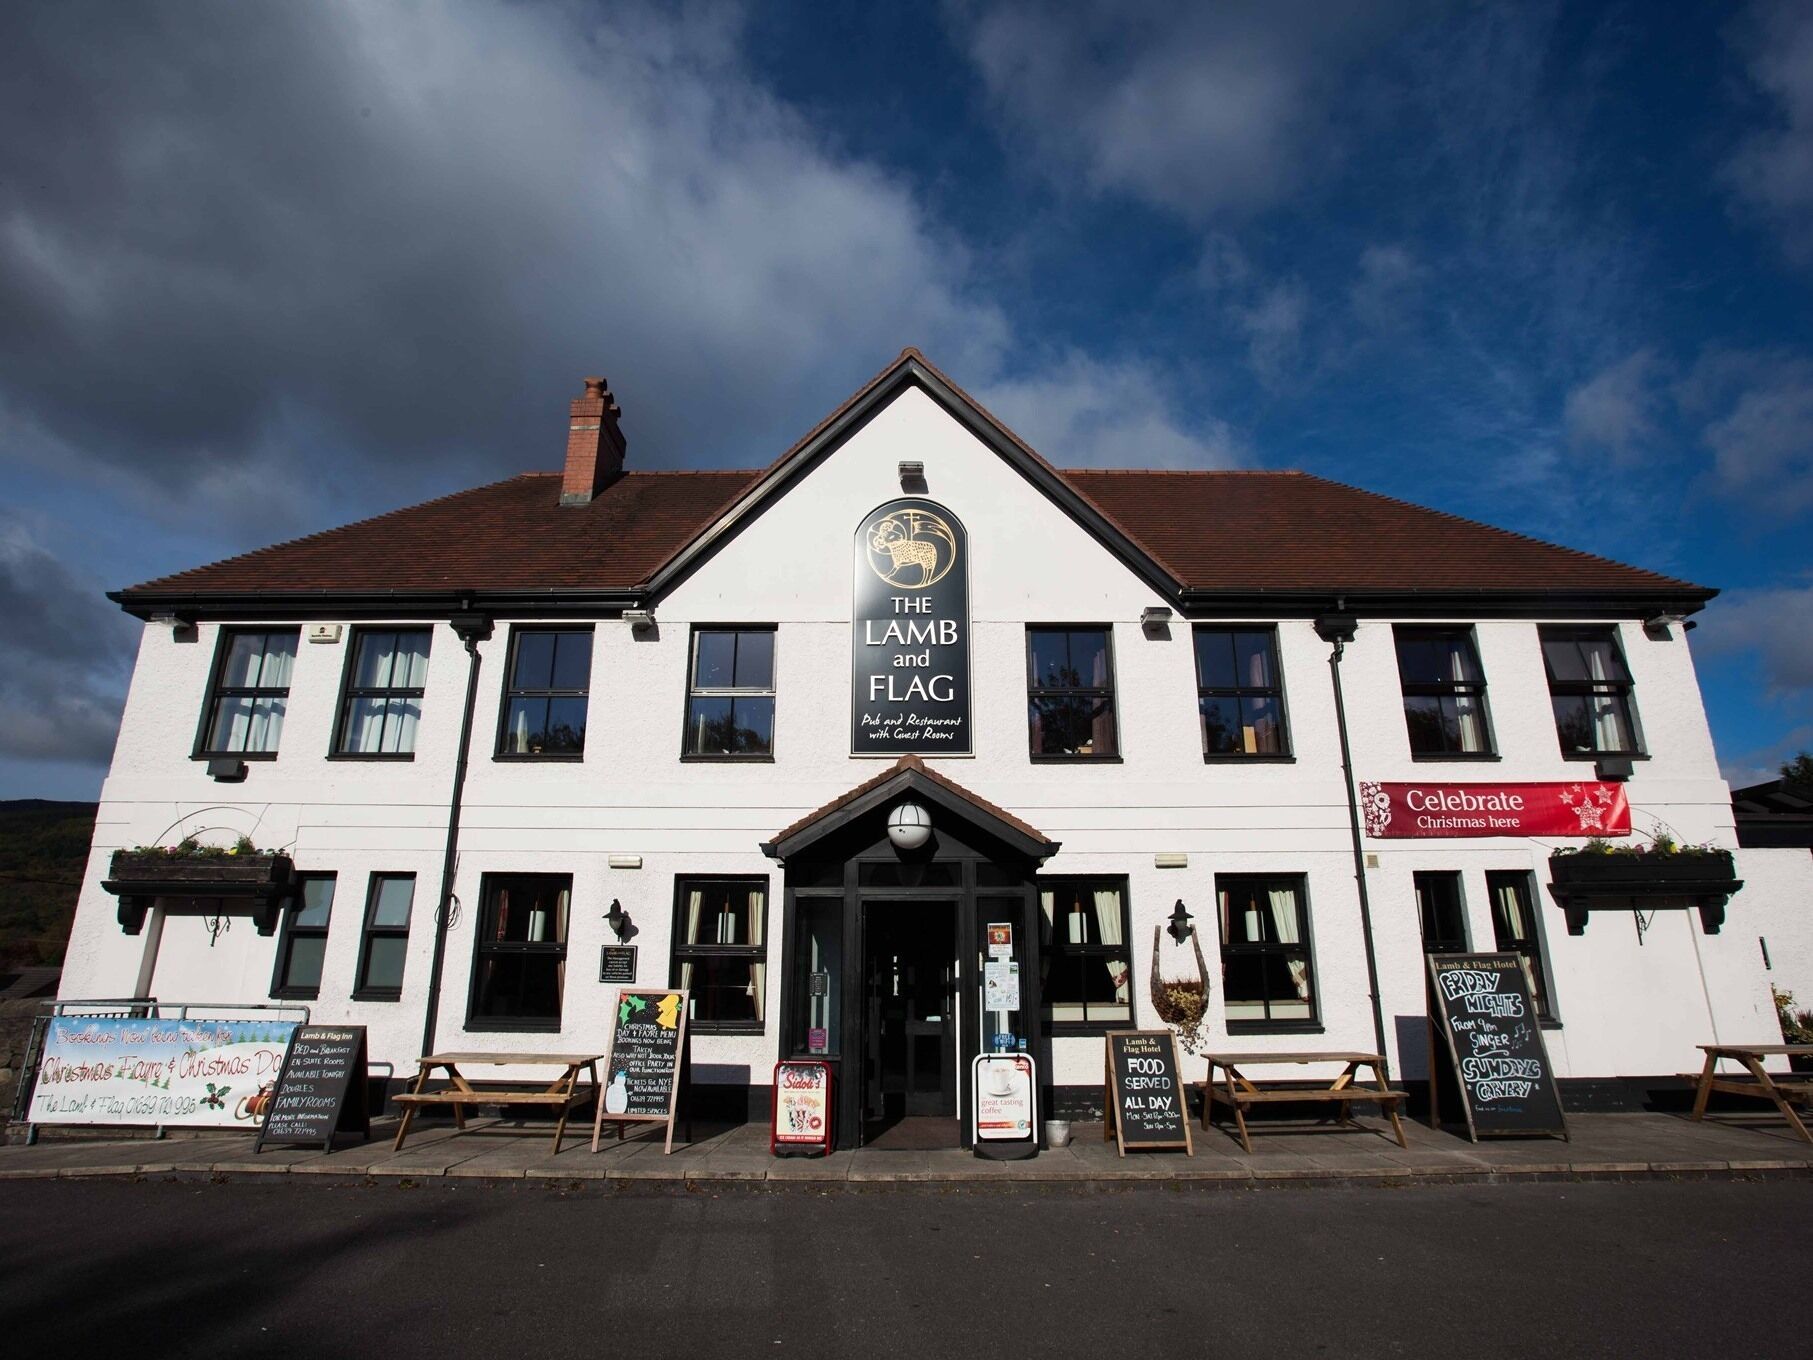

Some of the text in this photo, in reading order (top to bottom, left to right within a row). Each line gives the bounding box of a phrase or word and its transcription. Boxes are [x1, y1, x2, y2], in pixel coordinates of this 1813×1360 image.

[890, 597, 932, 614] THE
[866, 619, 958, 645] LAMB
[893, 649, 930, 667] and
[869, 674, 954, 702] FLAG
[861, 713, 962, 726] Pub and Restaurant
[869, 727, 954, 739] with Guest Rooms
[1406, 790, 1525, 812] Celebrate
[1417, 815, 1520, 829] Christmas here
[1435, 960, 1517, 970] Lamb & Flag Hotel
[1439, 970, 1500, 1001] FRIDAY
[1464, 993, 1525, 1017] NIGHTS
[624, 1023, 657, 1031] CHRISTMAS
[1451, 1016, 1476, 1032] FROM
[300, 1032, 320, 1040] Lamb
[320, 1032, 326, 1040] &
[327, 1033, 341, 1041] Flag
[617, 1029, 630, 1037] DAY
[638, 1030, 659, 1038] FAYRE
[617, 1036, 642, 1044] BOOKINGS
[1469, 1031, 1510, 1051] SINGER
[293, 1043, 310, 1055] BED
[1123, 1045, 1161, 1054] Flag Hotel
[324, 1057, 345, 1065] ROOMS
[1127, 1058, 1165, 1075] FOOD
[41, 1049, 283, 1088] Christmas Fayre & Christmas Da
[281, 1084, 315, 1094] DOUBLES
[1125, 1077, 1171, 1090] SERVED
[1476, 1080, 1532, 1102] CARVERY
[37, 1094, 57, 1113] The
[59, 1094, 88, 1114] Lamb
[99, 1095, 124, 1119] Flag
[275, 1095, 336, 1108] FAMILY ROOMS
[981, 1098, 1024, 1107] great tasting
[1124, 1096, 1172, 1111] ALL DAY
[1126, 1112, 1140, 1120] MON
